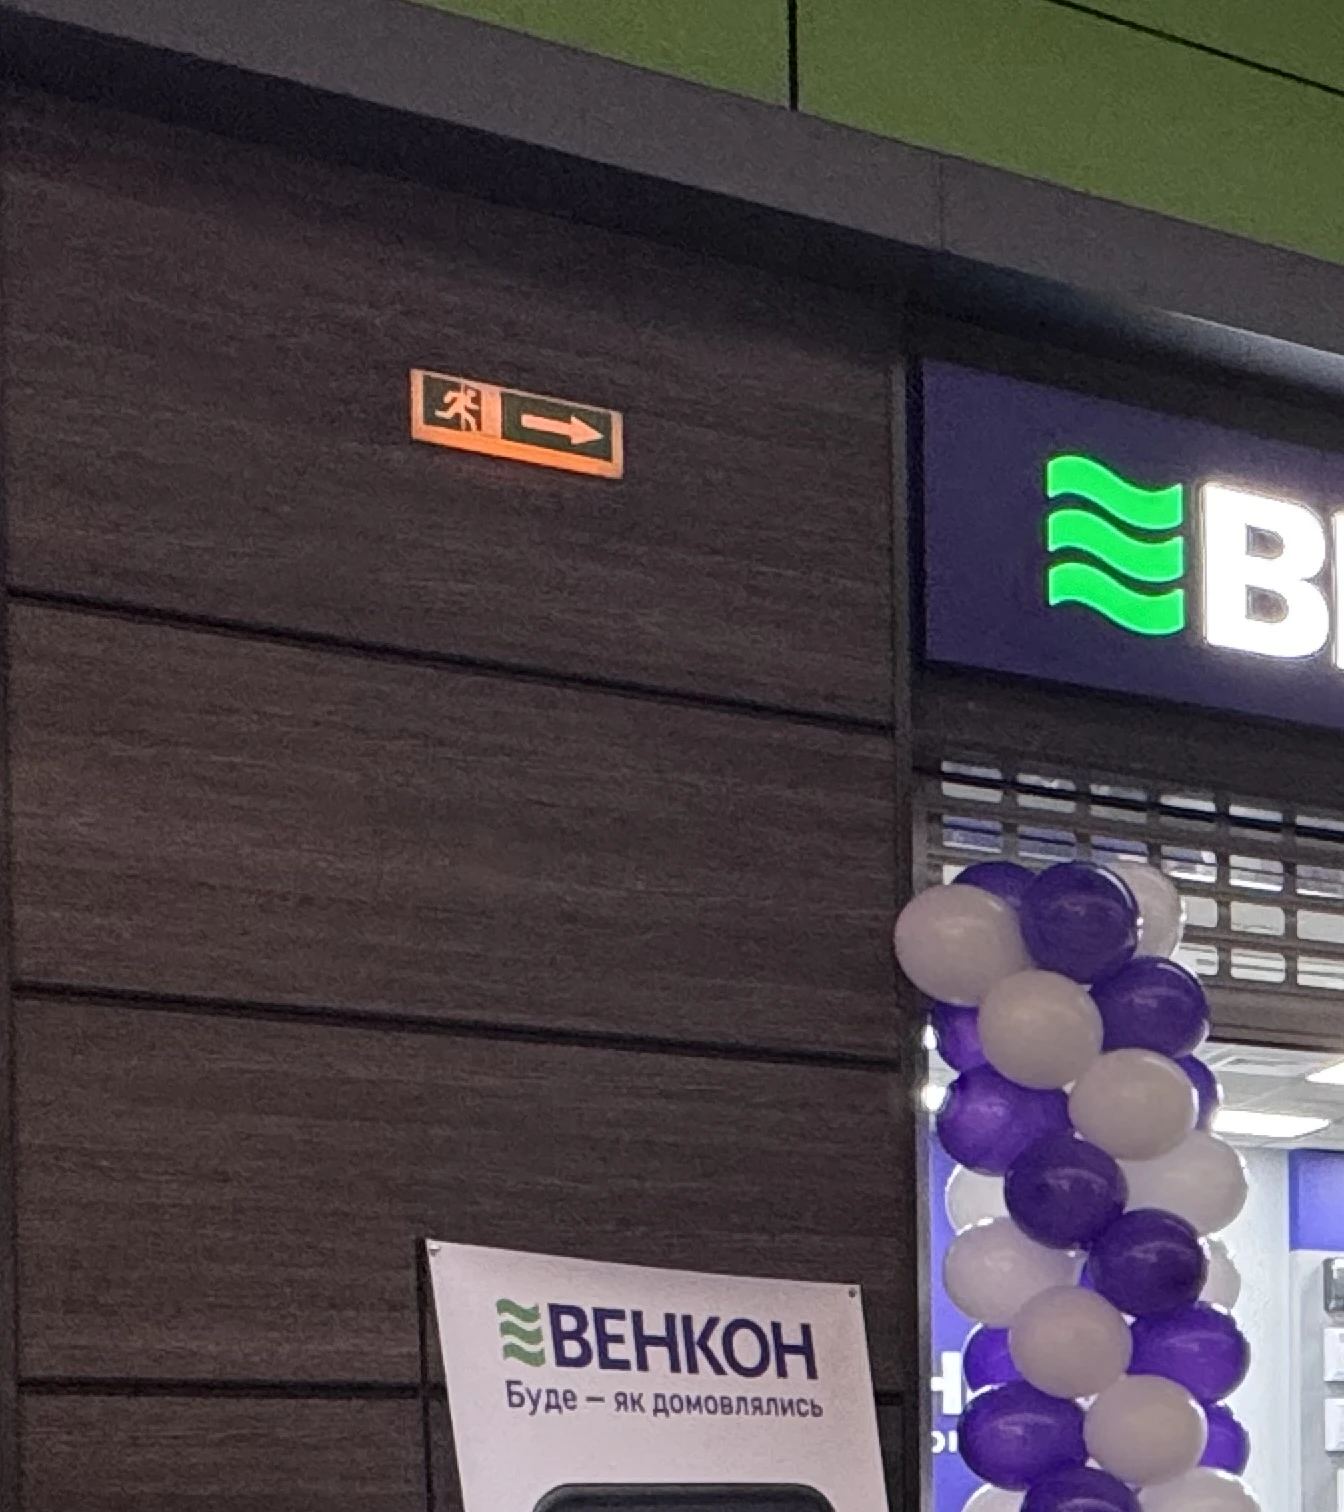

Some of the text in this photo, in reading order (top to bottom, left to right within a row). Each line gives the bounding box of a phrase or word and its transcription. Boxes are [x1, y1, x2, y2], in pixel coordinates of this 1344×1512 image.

[548, 1302, 818, 1380] ВЕНКОН
[505, 1380, 578, 1415] Буде
[614, 1392, 646, 1413] як
[652, 1393, 824, 1417] домовлялись
